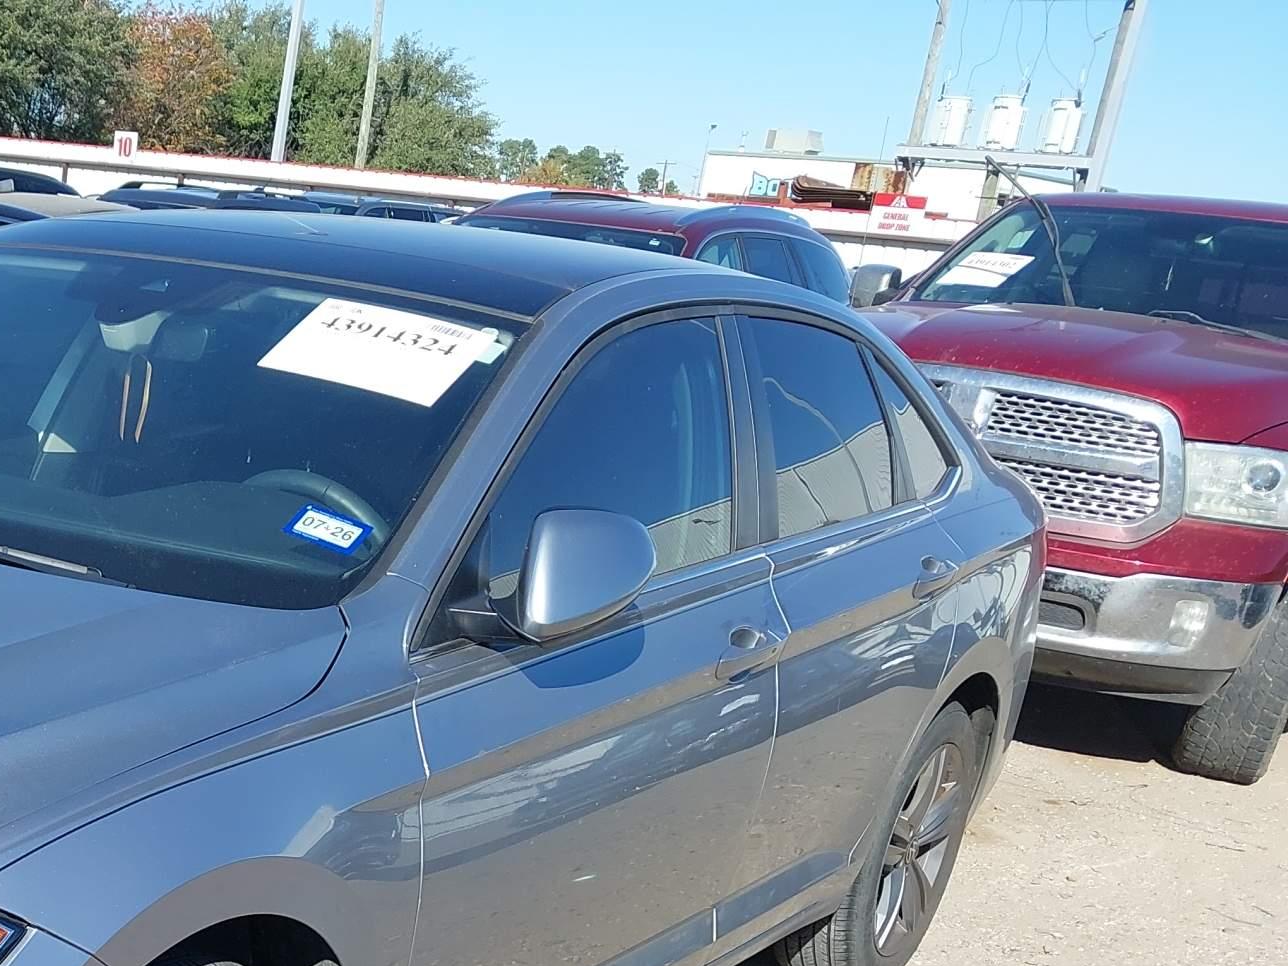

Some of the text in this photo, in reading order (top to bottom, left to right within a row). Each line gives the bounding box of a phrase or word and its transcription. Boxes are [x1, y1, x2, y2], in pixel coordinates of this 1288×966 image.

[116, 135, 132, 157] 10
[877, 222, 911, 232] DROP ZONE
[882, 212, 910, 222] GENERAL
[320, 316, 459, 356] 43914324
[301, 515, 356, 542] 07-26
